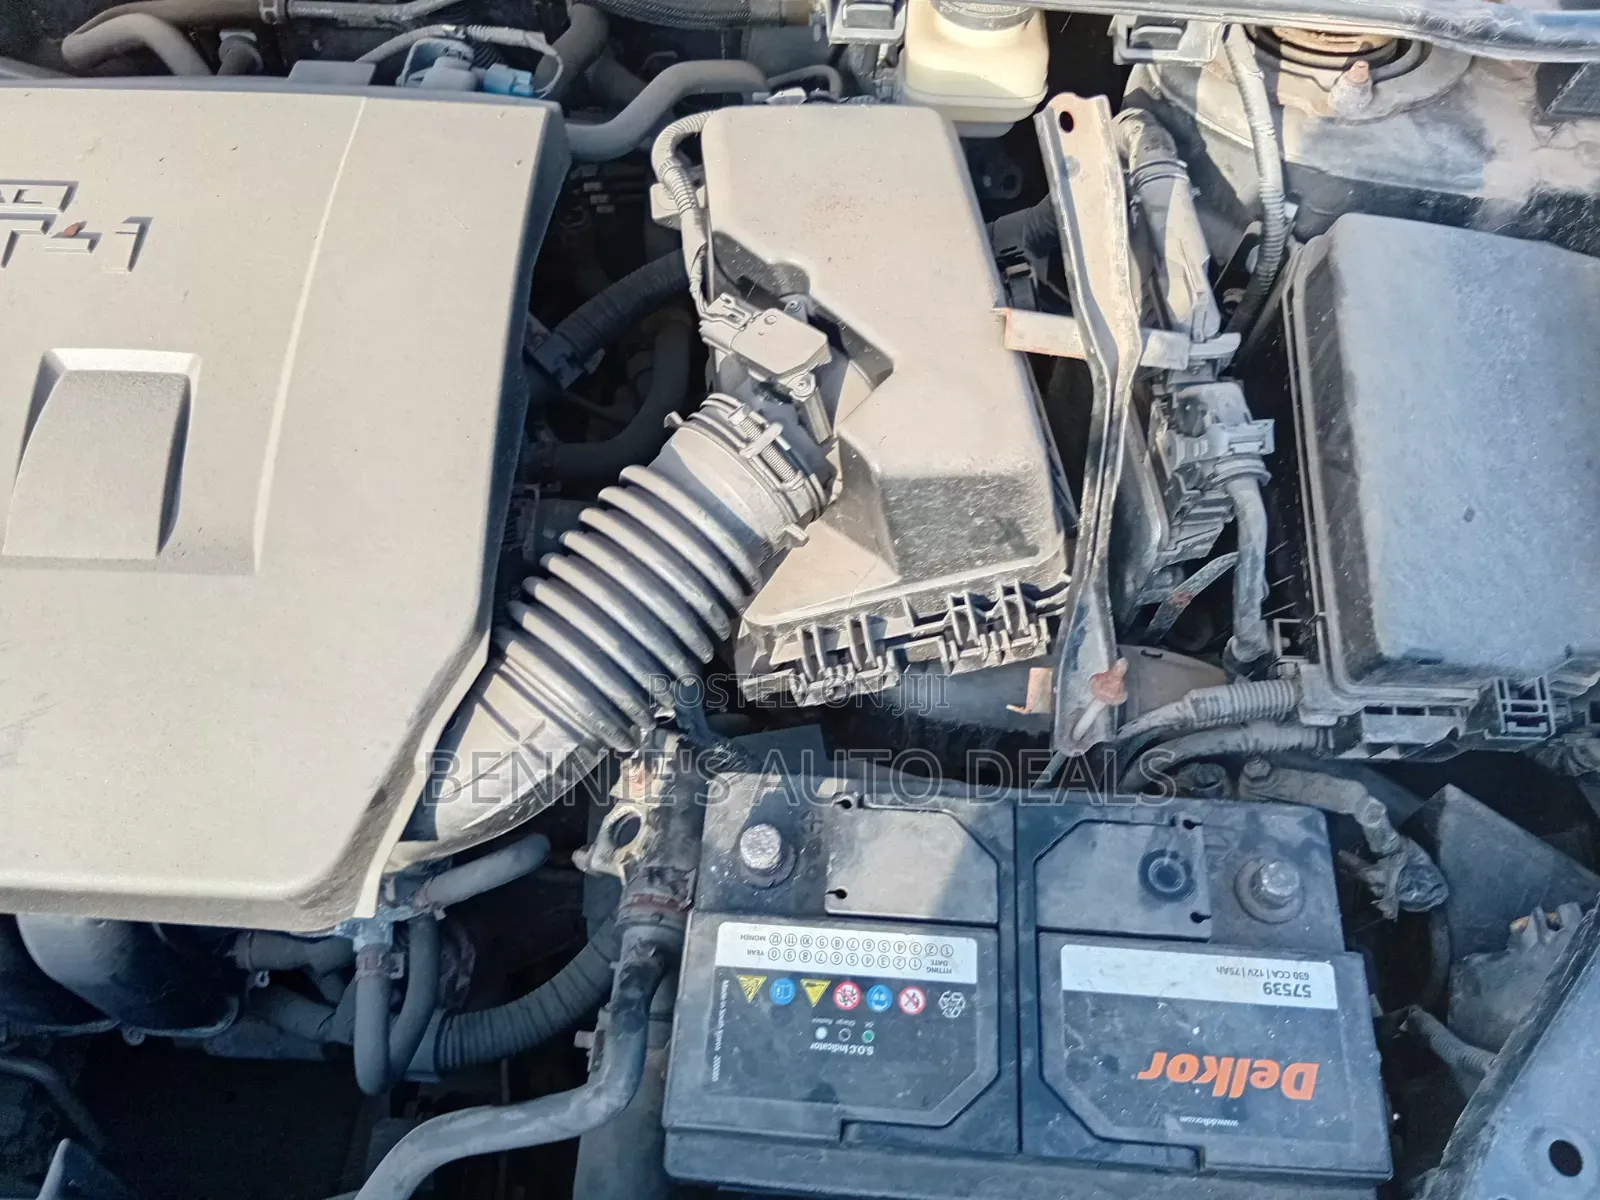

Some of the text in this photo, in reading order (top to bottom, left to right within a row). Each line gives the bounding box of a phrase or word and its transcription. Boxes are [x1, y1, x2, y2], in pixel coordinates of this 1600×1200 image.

[747, 949, 765, 957] YEAR
[926, 966, 953, 974] FITTING
[1216, 966, 1310, 980] 630 CCA 12V 75Ah
[1263, 981, 1312, 999] 57539
[809, 1042, 849, 1055] Indicator
[1137, 1051, 1320, 1101] Delkor
